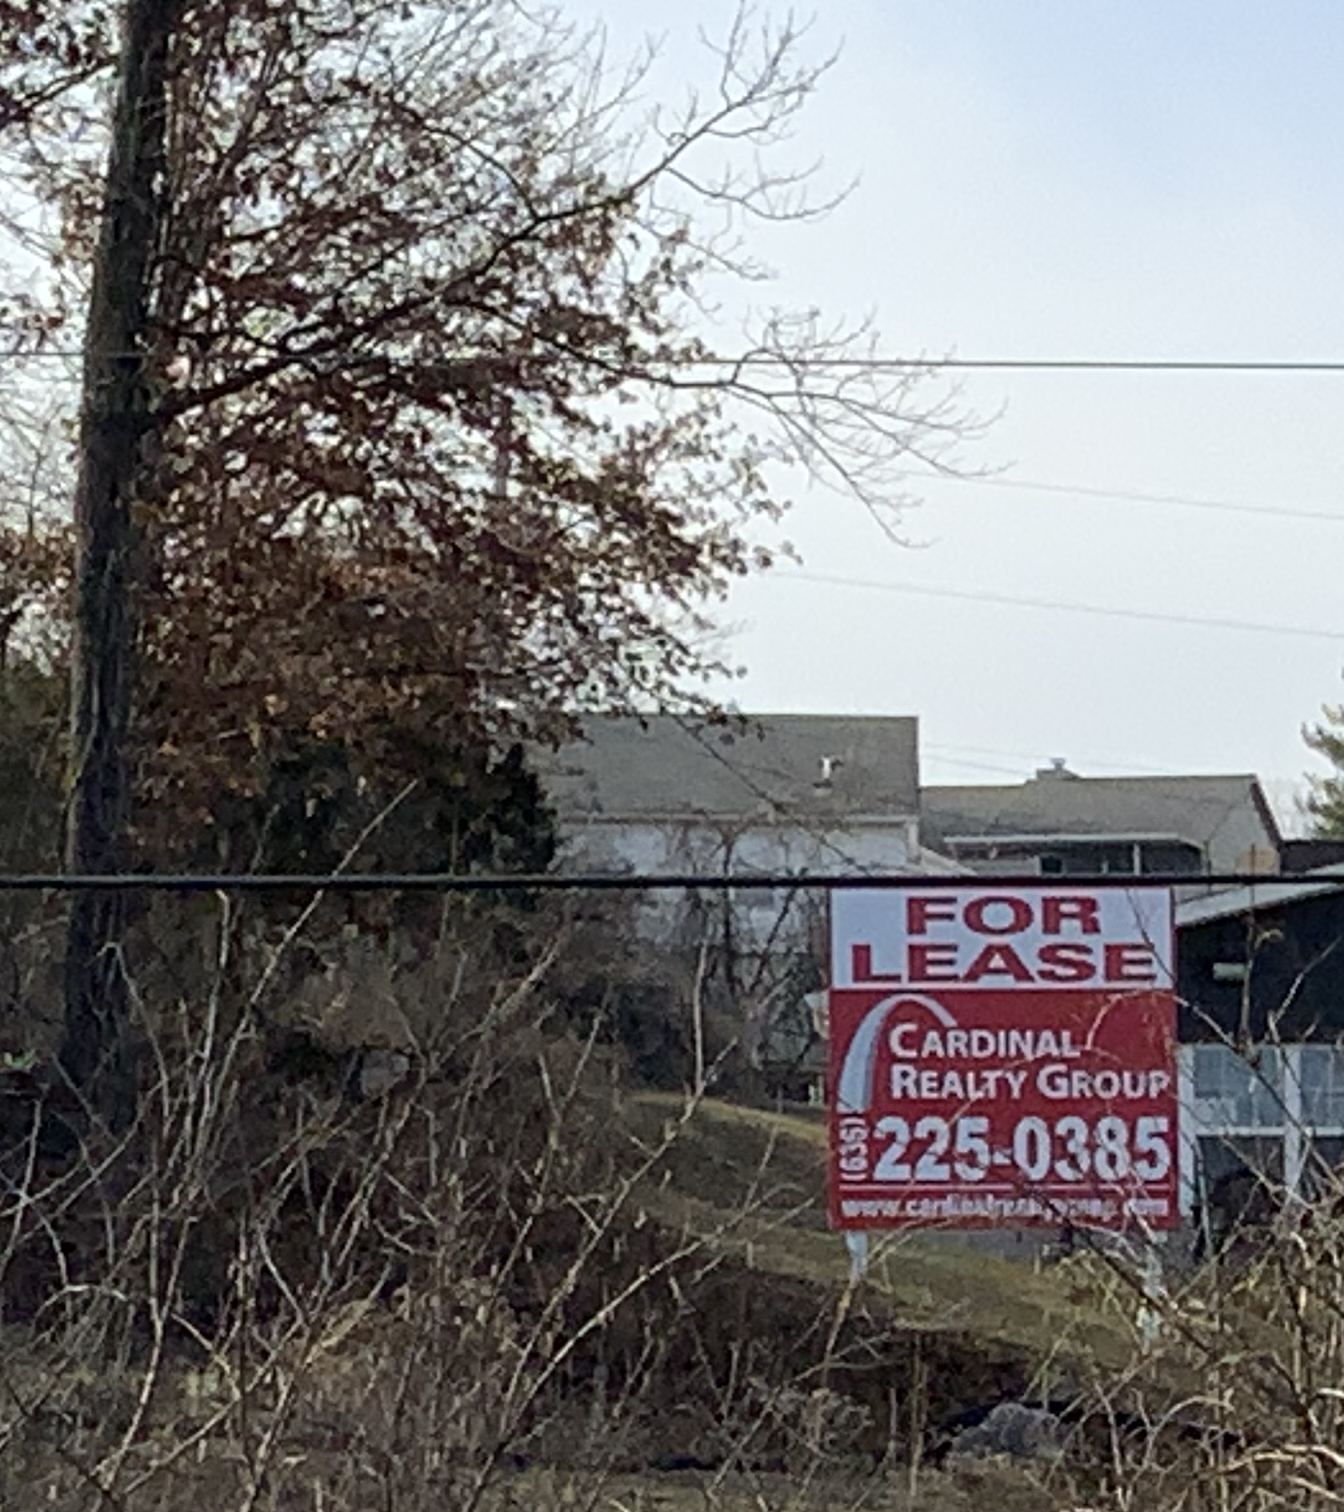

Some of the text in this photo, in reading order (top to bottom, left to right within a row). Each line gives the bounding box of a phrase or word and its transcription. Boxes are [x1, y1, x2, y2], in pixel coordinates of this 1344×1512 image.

[906, 895, 1102, 935] FOR
[850, 943, 1158, 983] LEASE
[872, 1115, 1173, 1183] 225-0385
